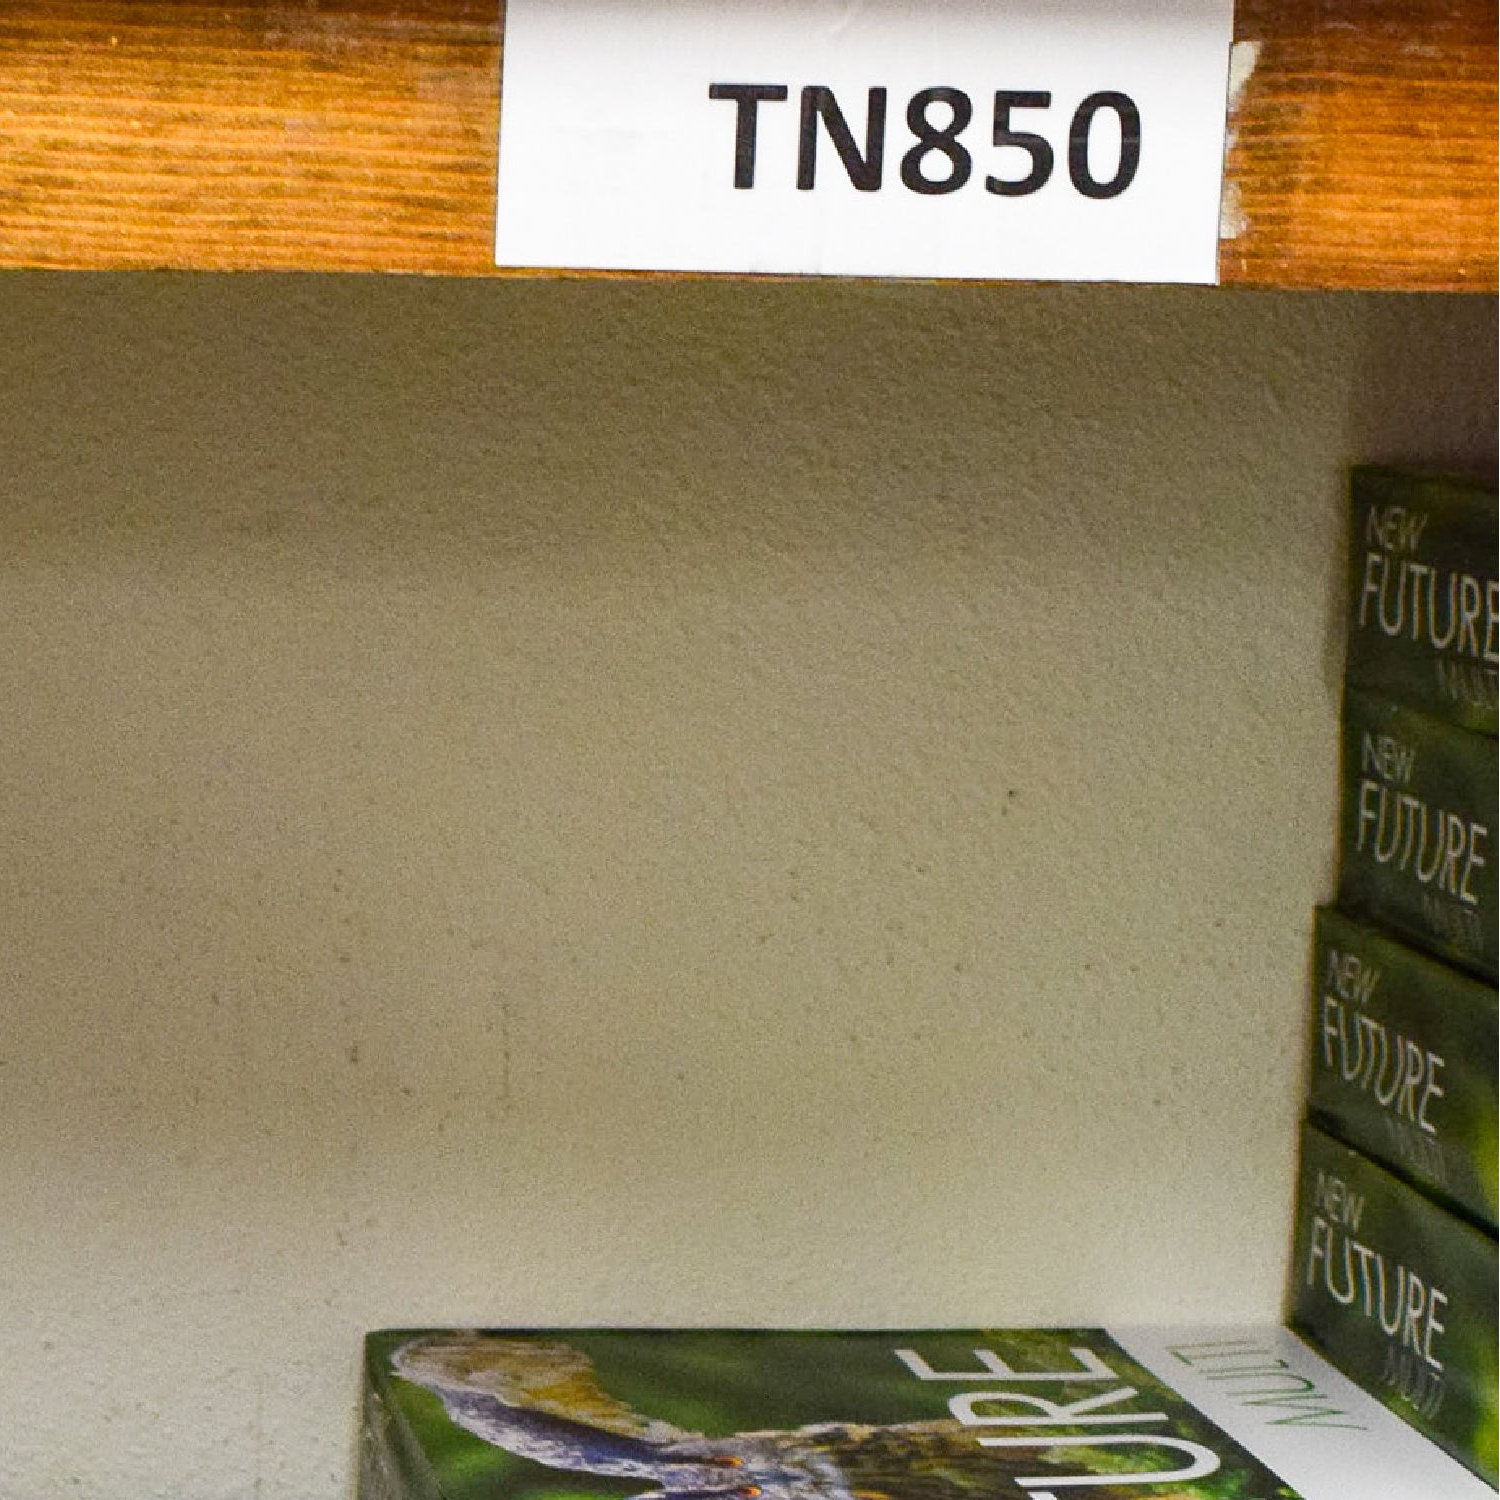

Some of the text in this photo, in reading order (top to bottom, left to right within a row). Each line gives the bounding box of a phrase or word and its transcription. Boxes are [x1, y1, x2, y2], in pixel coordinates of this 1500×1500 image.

[708, 83, 1141, 199] TN850
[1366, 504, 1428, 551] NEW
[1359, 553, 1499, 663] FUTURE
[1361, 730, 1417, 782] NEW
[1357, 779, 1487, 905] FUTURE
[1328, 950, 1380, 1003] NEW
[1322, 999, 1445, 1133] FUTURE
[1317, 1171, 1365, 1233] NEW
[1306, 1217, 1448, 1371] FUTURE
[1165, 1341, 1370, 1431] MULTI
